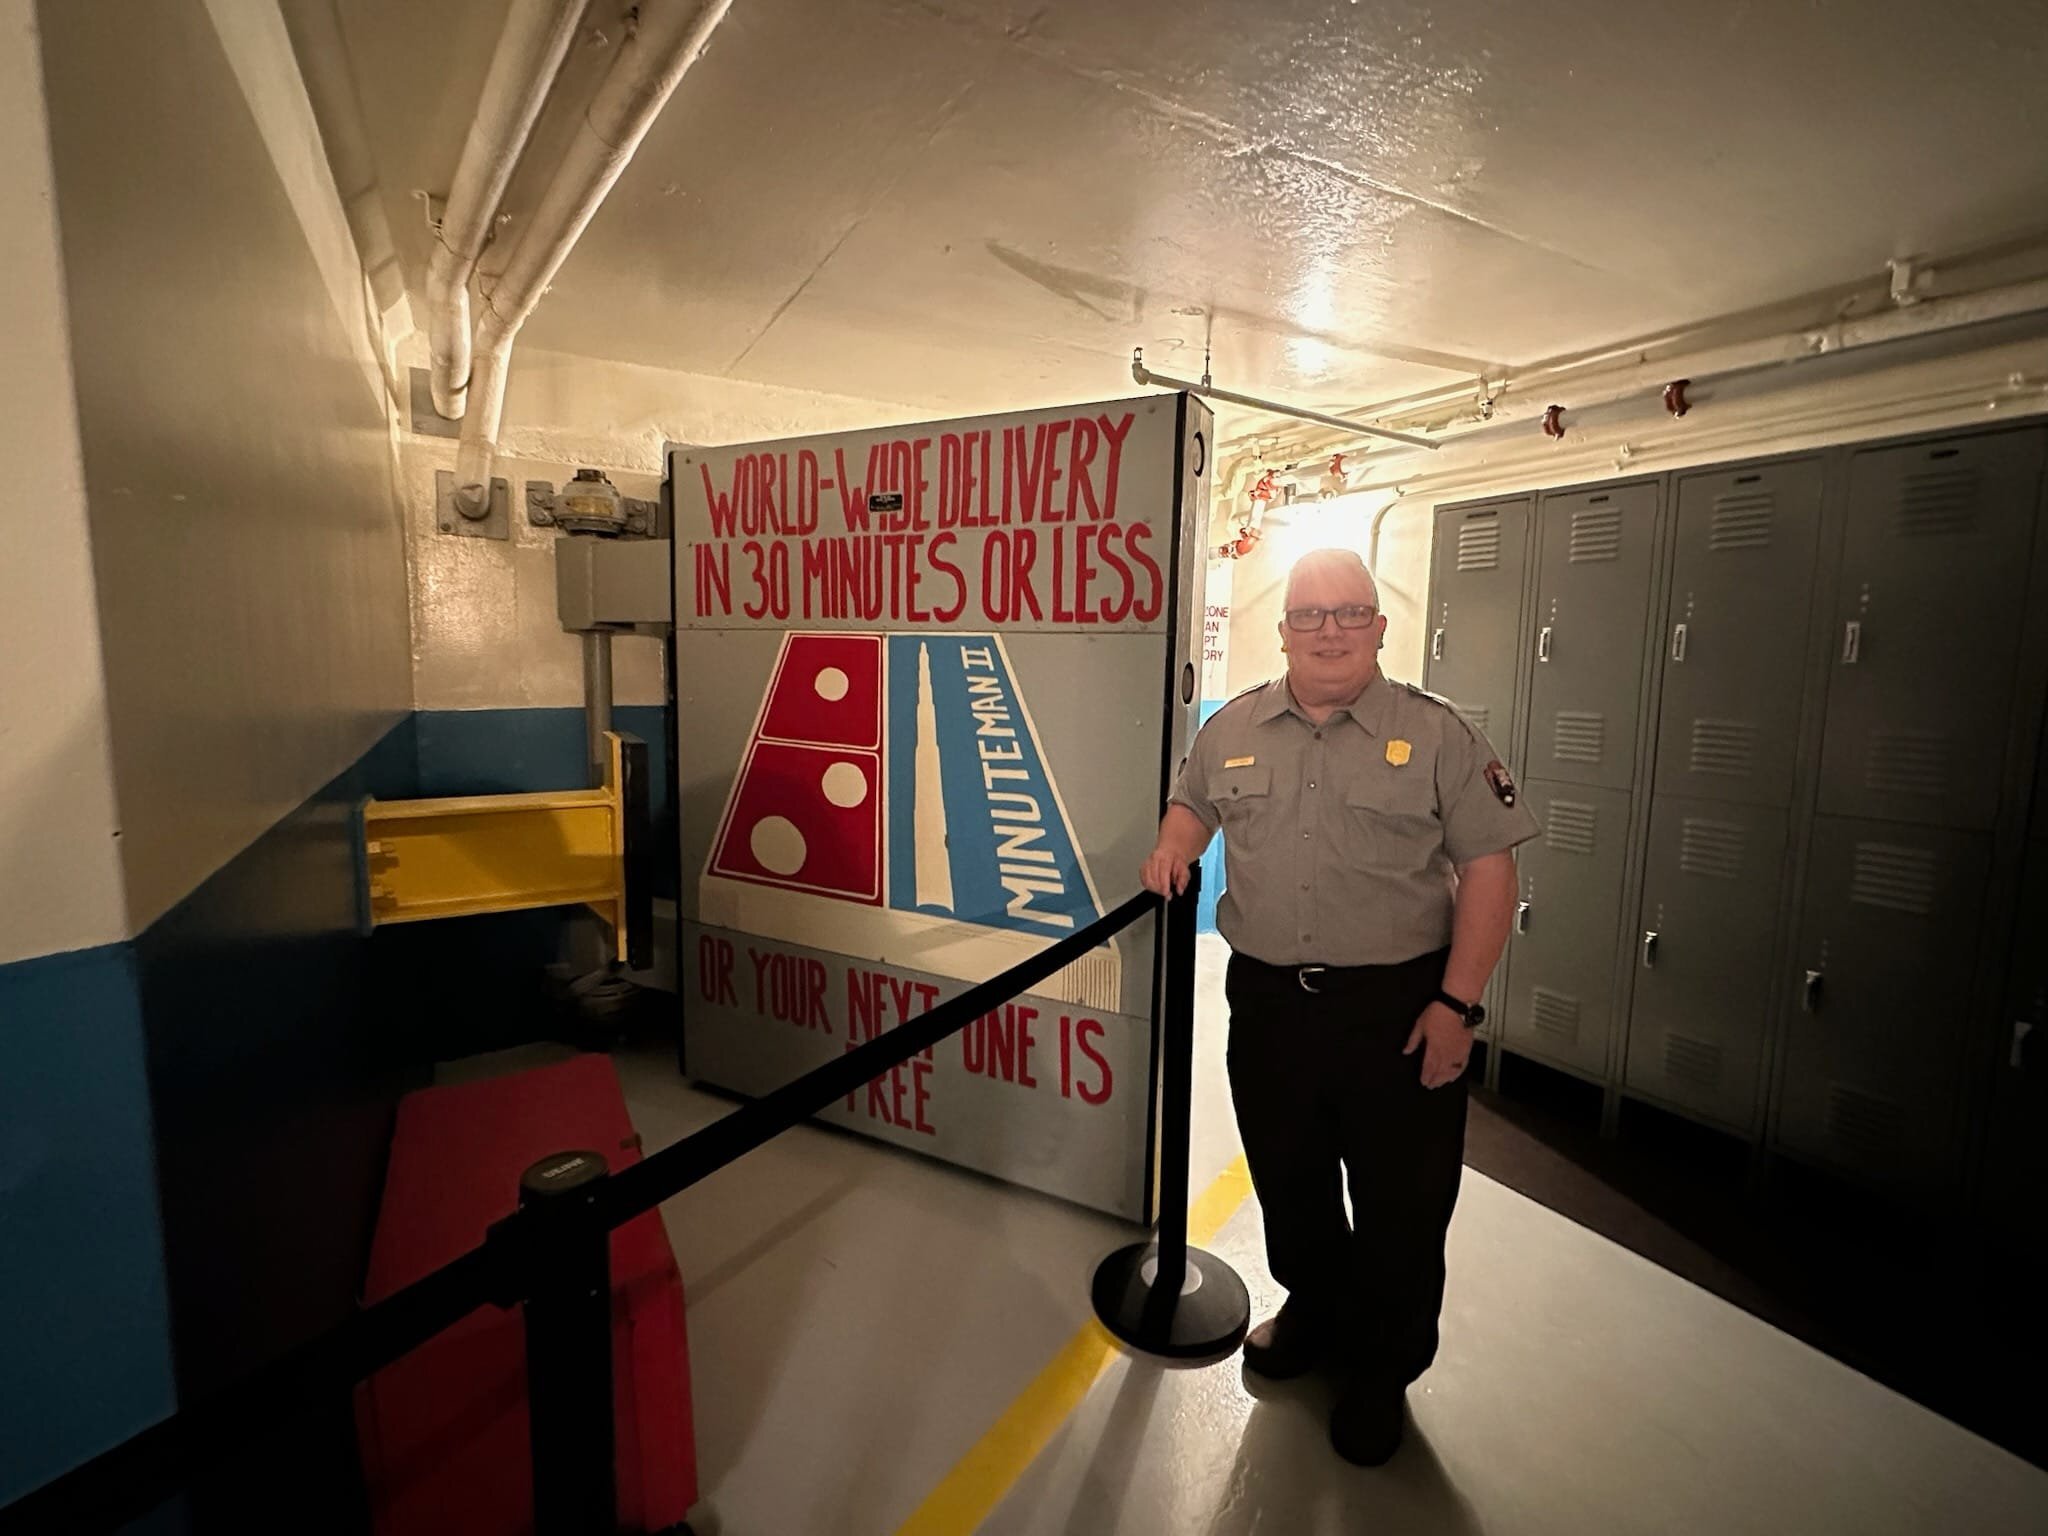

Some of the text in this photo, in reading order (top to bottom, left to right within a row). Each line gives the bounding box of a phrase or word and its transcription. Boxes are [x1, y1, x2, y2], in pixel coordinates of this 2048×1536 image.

[700, 412, 1136, 538] WORLD-WIDE DELIVERY
[695, 522, 1164, 624] IN 30 MINUTES OR LESS
[960, 645, 1075, 928] MINUTEMAN II
[700, 934, 738, 1008] OR
[748, 946, 833, 1034] YOUR
[1060, 1016, 1112, 1106] IS
